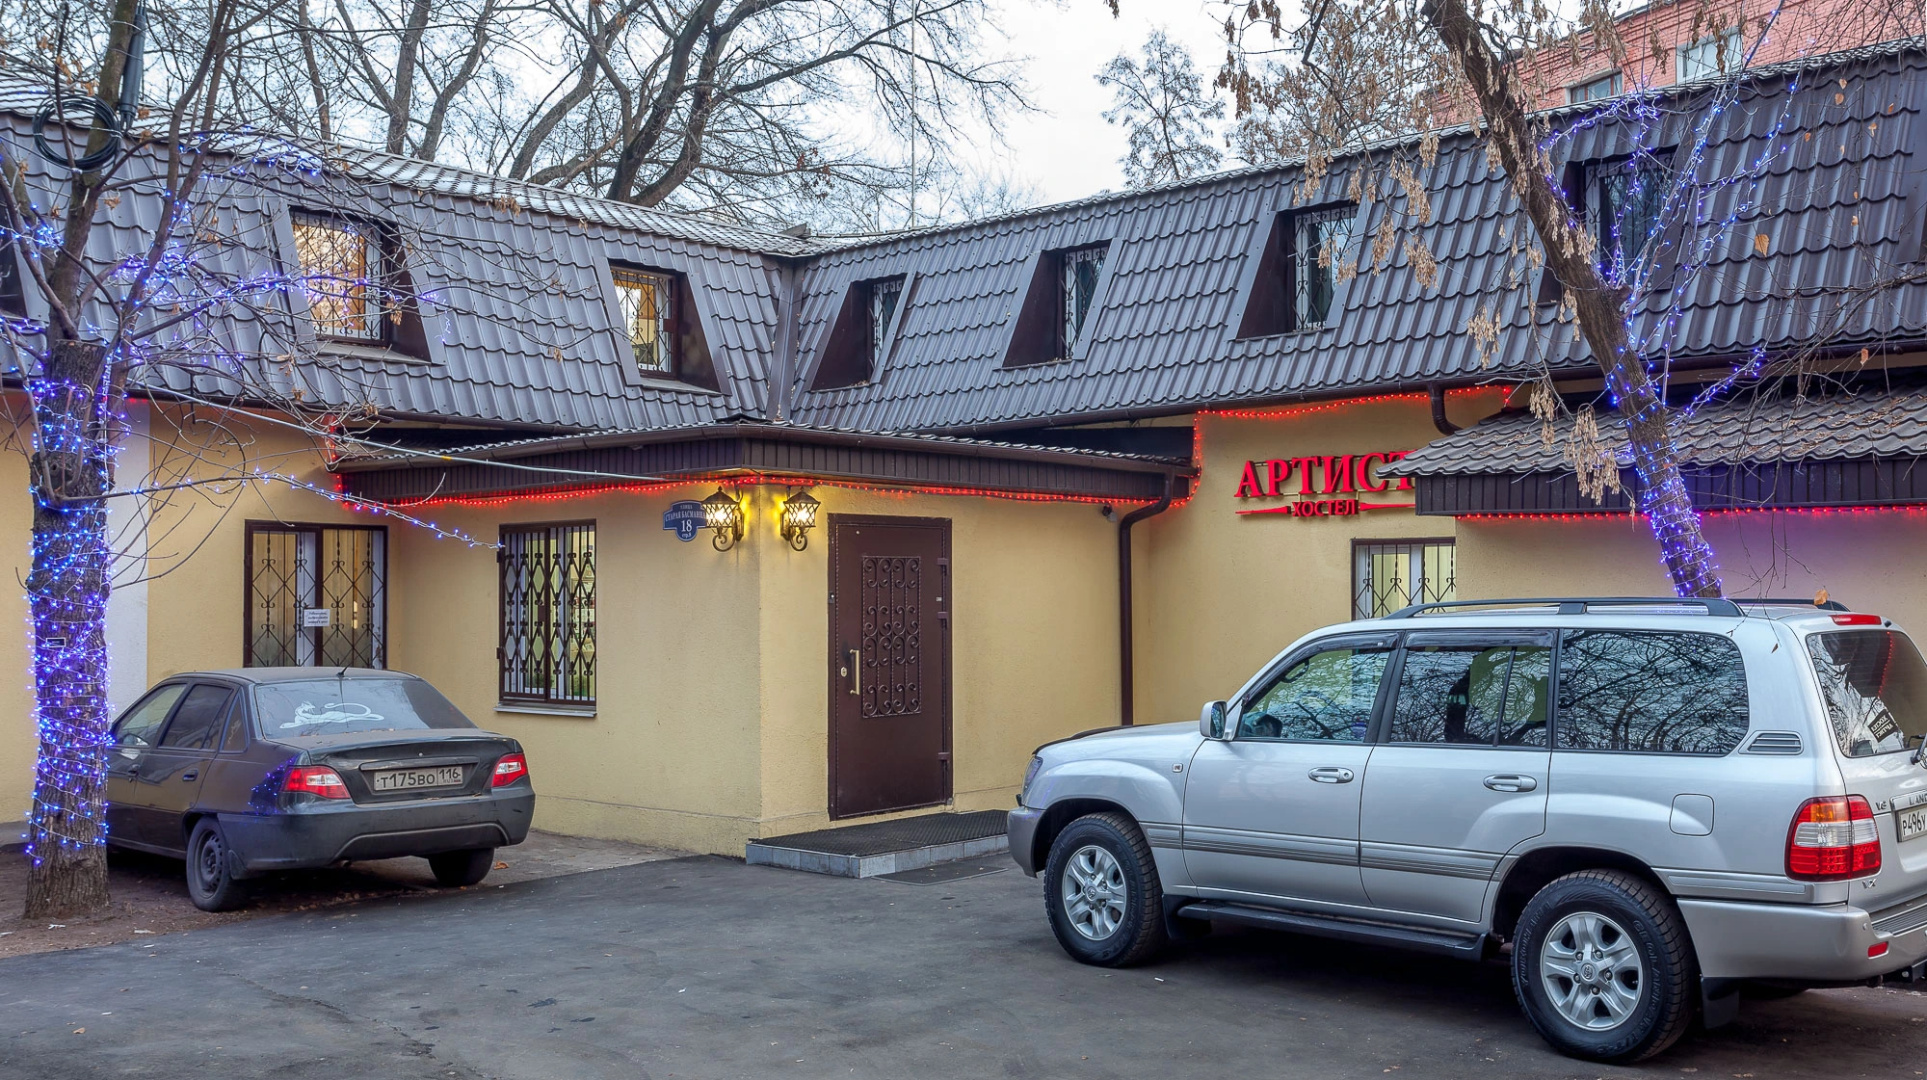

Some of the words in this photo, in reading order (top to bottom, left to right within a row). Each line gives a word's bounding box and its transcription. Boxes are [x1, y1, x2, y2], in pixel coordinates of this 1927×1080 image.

[1292, 499, 1357, 517] ХОСТЕЛ
[681, 519, 693, 532] 18
[439, 768, 459, 780] 116
